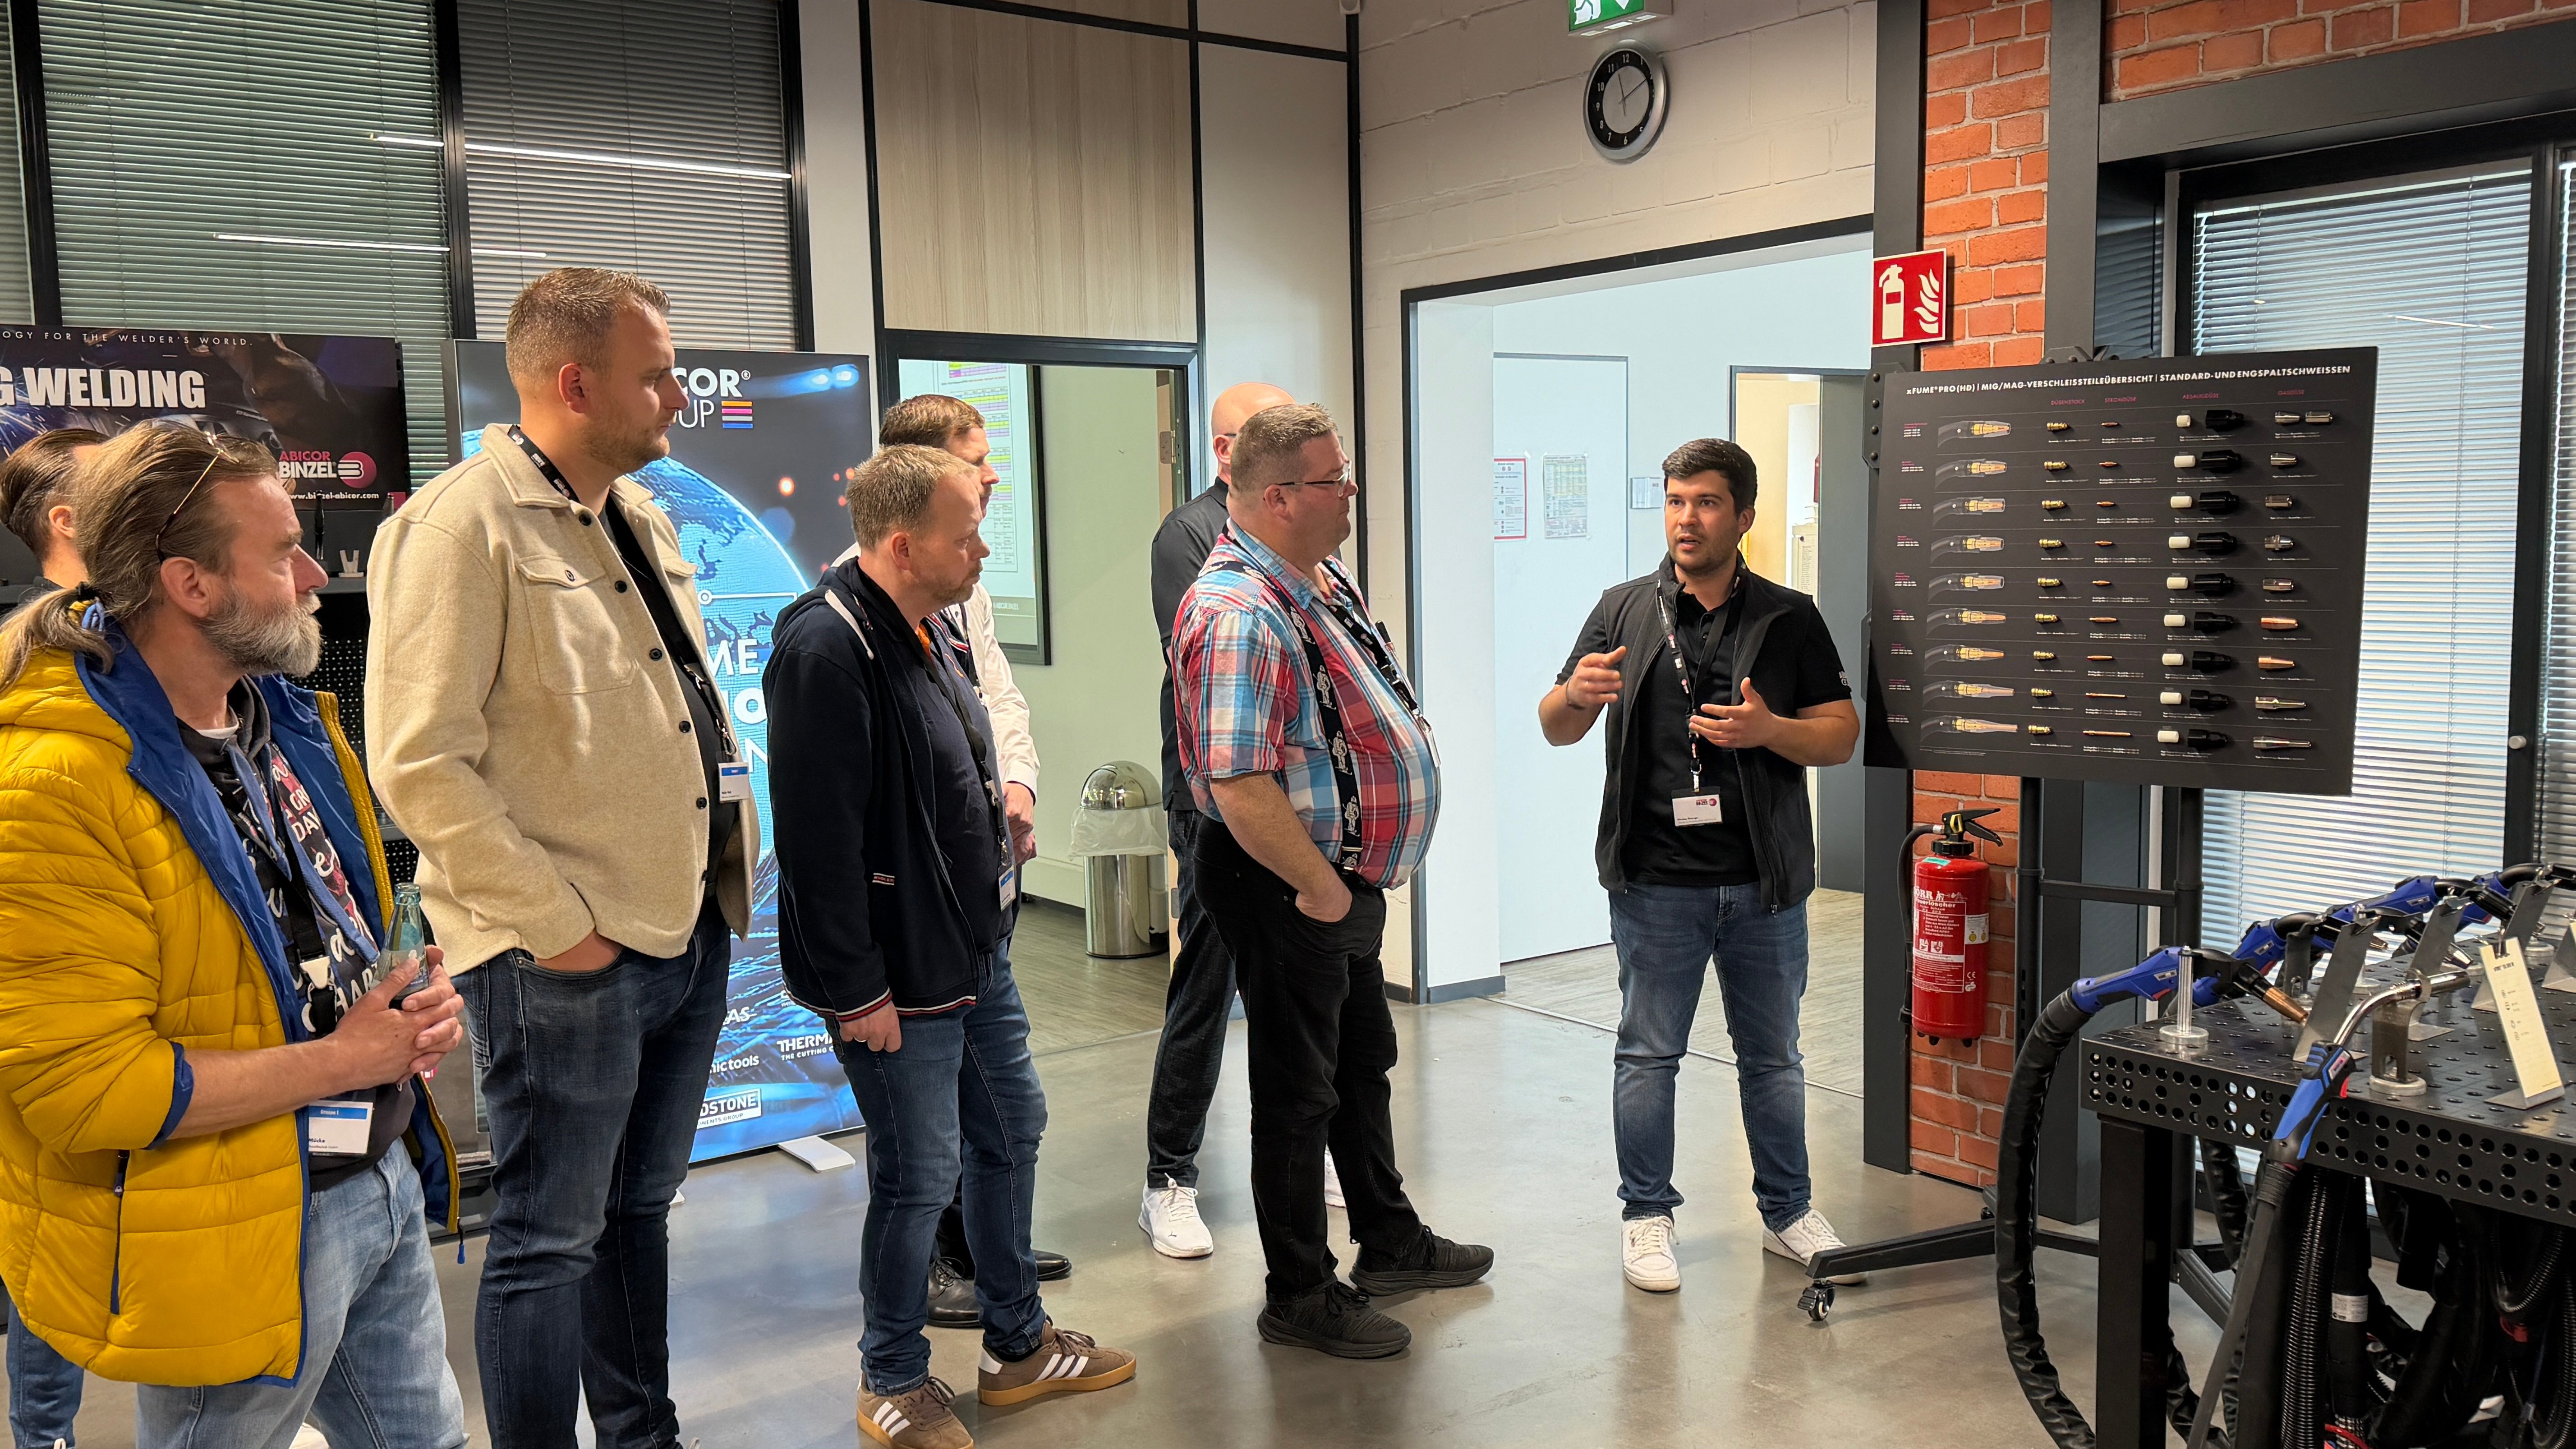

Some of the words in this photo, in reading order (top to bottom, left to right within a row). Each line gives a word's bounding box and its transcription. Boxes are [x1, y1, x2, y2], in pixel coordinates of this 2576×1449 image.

[1623, 53, 1630, 63] 12
[1608, 64, 1614, 73] 11
[1597, 82, 1605, 92] 10
[1596, 102, 1601, 111] 9
[1600, 120, 1604, 129] 8
[1608, 132, 1612, 142] 7
[1624, 136, 1628, 145] 6
[2, 331, 33, 339] OGY
[83, 333, 108, 341] THE
[119, 335, 189, 344] WELDER'S
[199, 337, 253, 346] WORLD.
[23, 367, 206, 409] WELDING
[675, 400, 714, 428] UP
[279, 451, 331, 461] ABICOR
[290, 492, 379, 500] ww.bizel-abicor.com
[796, 1047, 827, 1058] CUTTING
